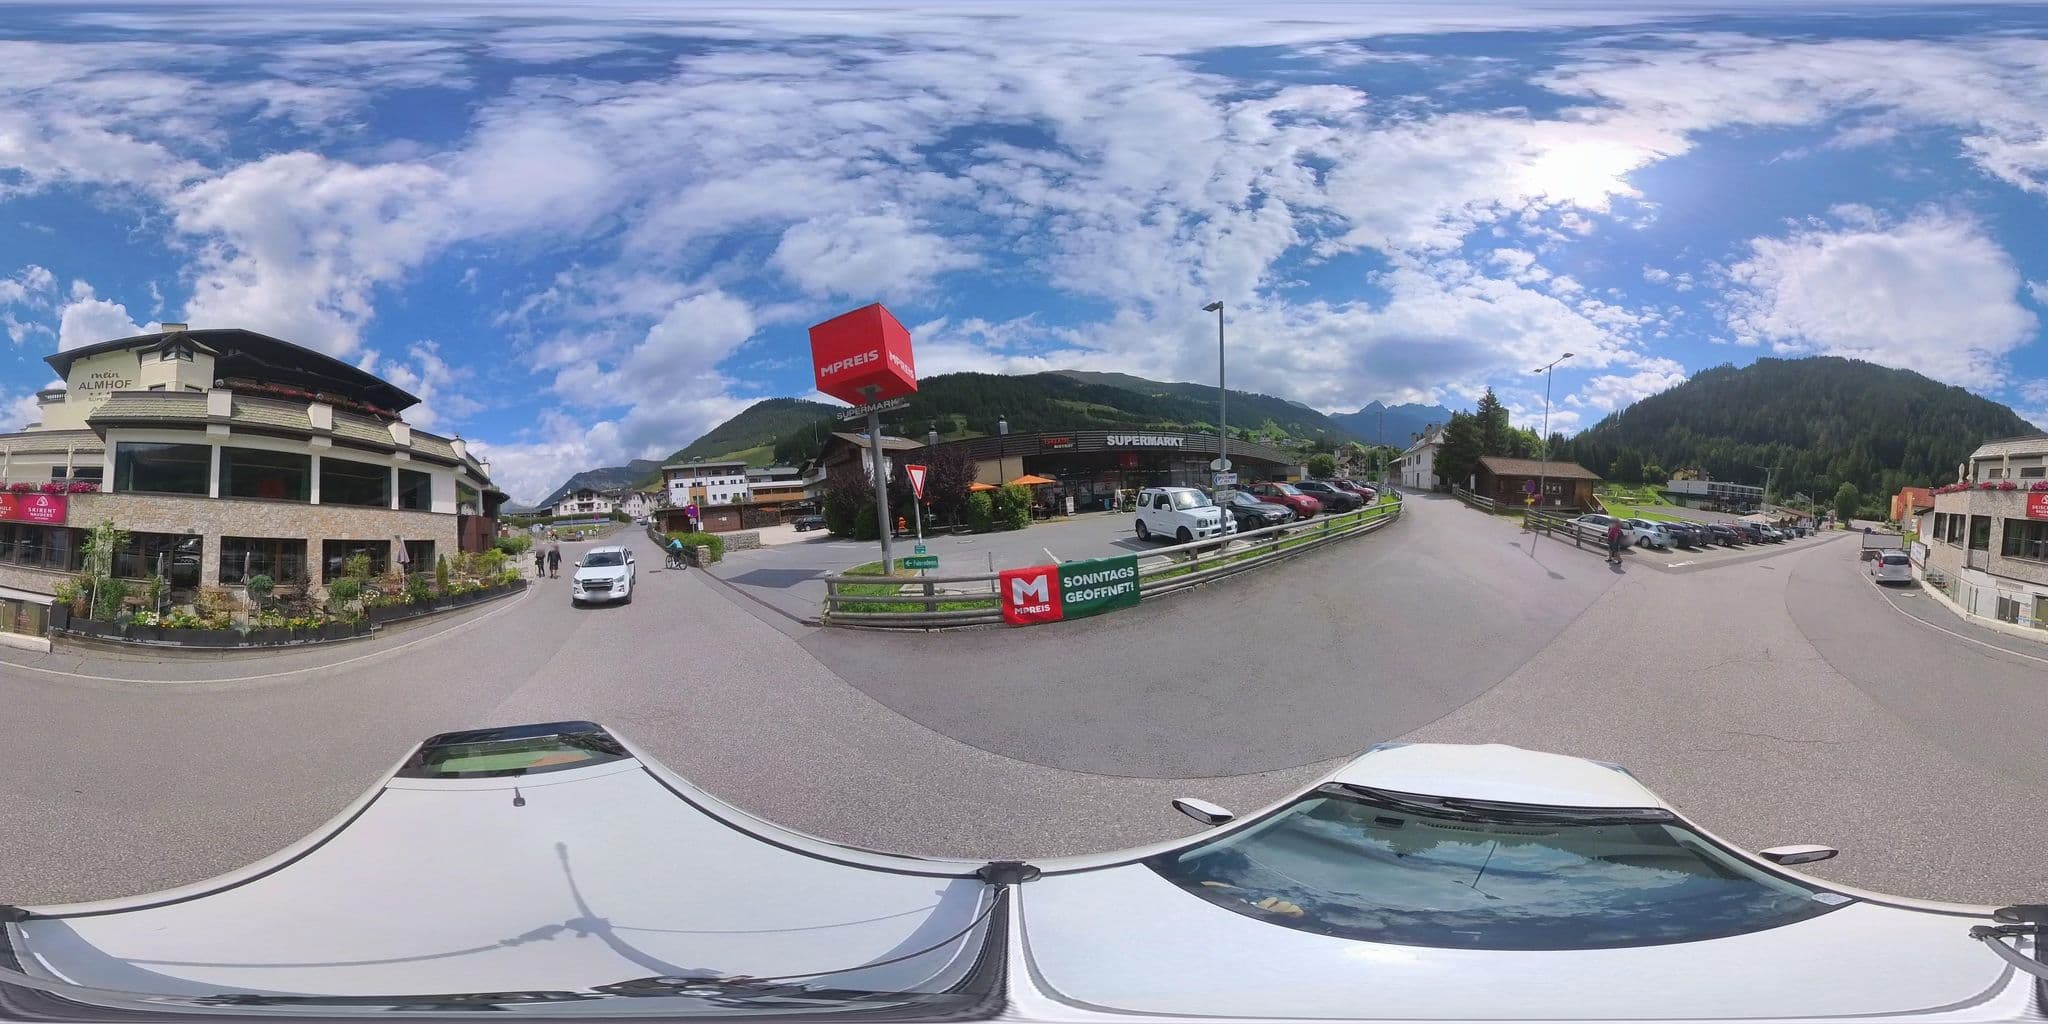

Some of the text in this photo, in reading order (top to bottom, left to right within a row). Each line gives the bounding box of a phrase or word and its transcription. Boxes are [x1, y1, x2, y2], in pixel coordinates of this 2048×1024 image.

[820, 349, 879, 377] MPREIS
[888, 350, 915, 379] MPREIS
[78, 379, 132, 390] ALMHOF
[1106, 435, 1184, 447] SUPERMARKT
[1063, 567, 1135, 588] SONNTAGS
[1011, 574, 1050, 605] M
[1065, 581, 1135, 603] GEÖFFNET!
[1014, 604, 1051, 615] MPREIS
